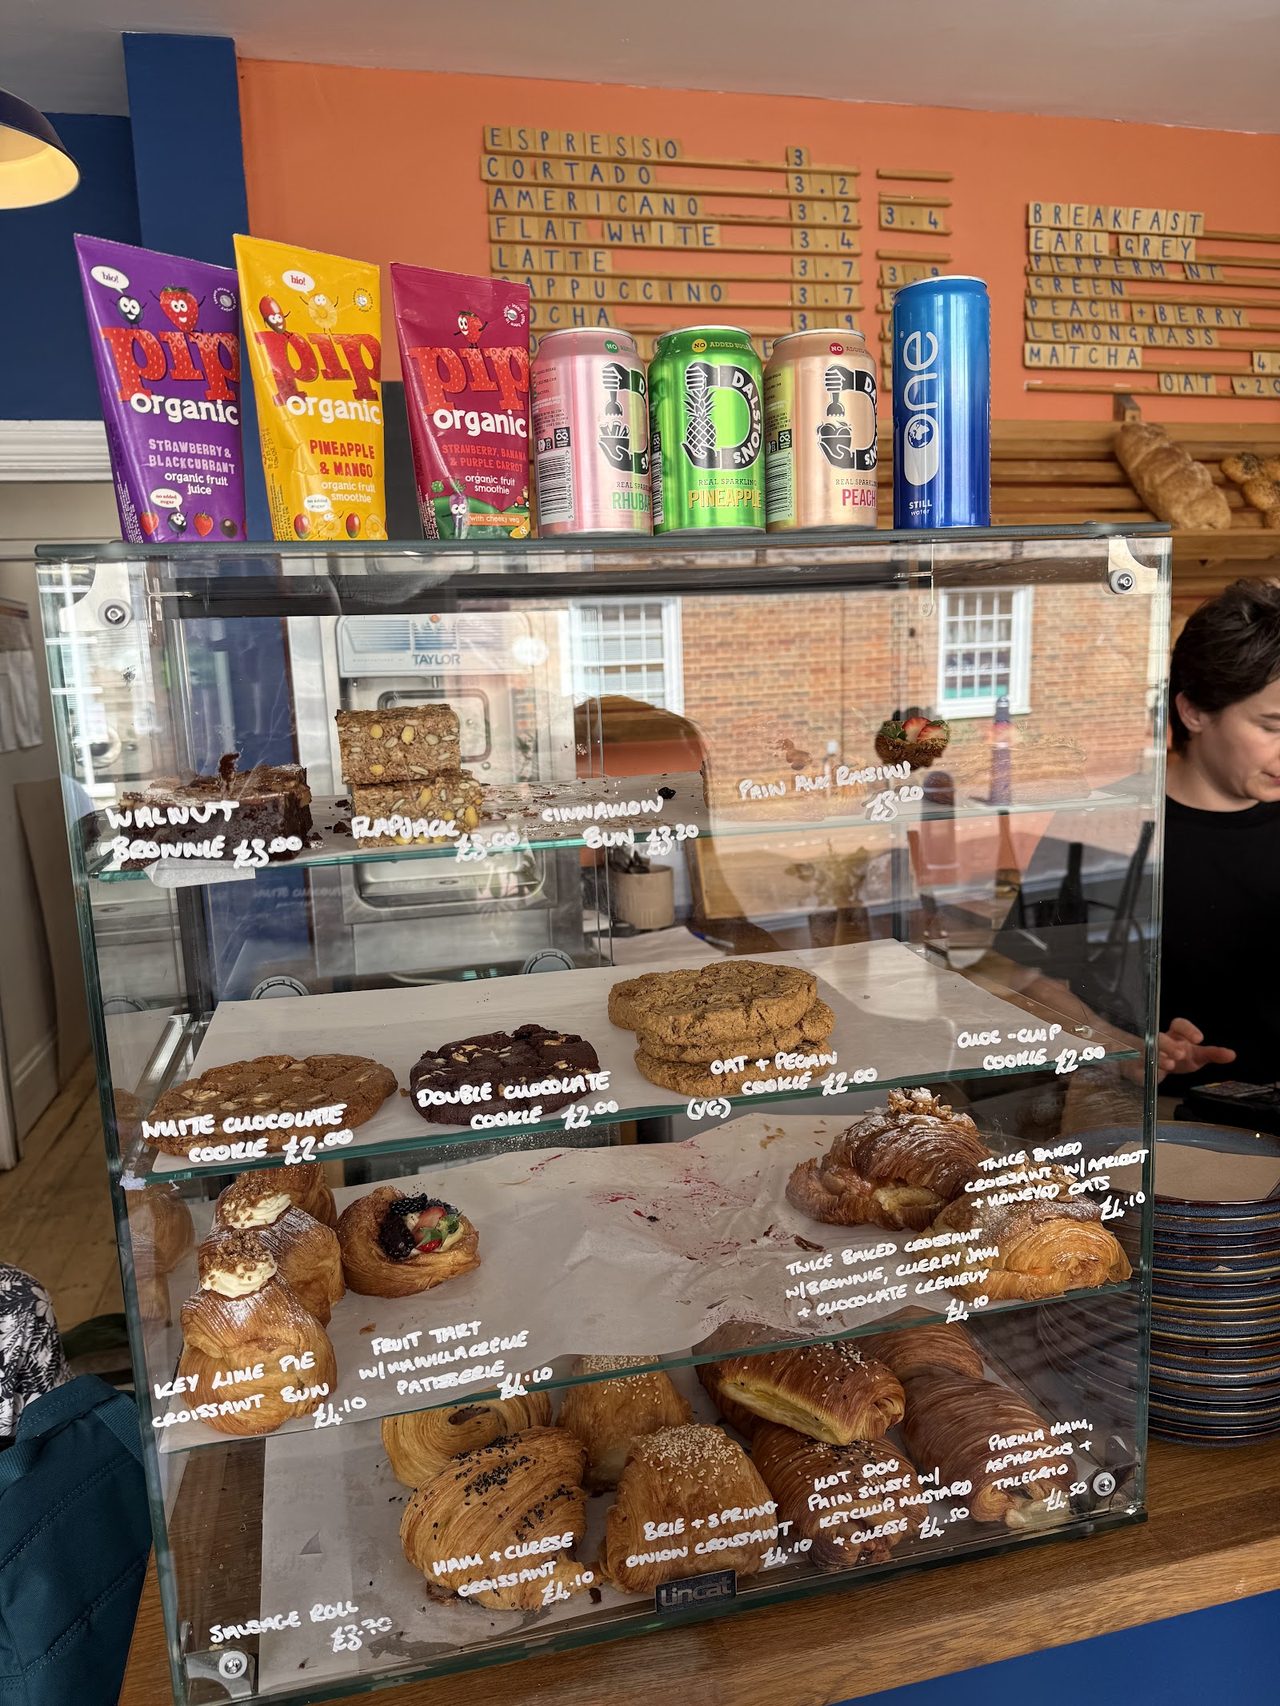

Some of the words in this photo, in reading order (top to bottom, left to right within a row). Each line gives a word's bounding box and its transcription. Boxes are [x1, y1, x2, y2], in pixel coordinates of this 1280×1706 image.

[491, 127, 677, 159] ESPRESSO
[794, 149, 803, 167] 3
[487, 156, 651, 185] CORTADO
[795, 175, 848, 195] 3.2
[493, 187, 698, 216] AMERICANO
[798, 203, 851, 223] 3.2
[885, 207, 938, 229] 3.4
[1033, 203, 1202, 233] BREAKFAST
[496, 217, 582, 241] FLAT
[607, 222, 716, 246] WHITE
[800, 230, 853, 249] 3.4
[1034, 229, 1104, 253] EARL
[1125, 237, 1192, 259] GREY
[498, 247, 606, 273] LATTE
[798, 260, 853, 278] 3.7
[290, 274, 306, 286] bio!
[504, 277, 722, 302] APPUCCINO
[798, 287, 853, 304] 3.7
[1034, 278, 1123, 297] GREEN
[1029, 299, 1120, 320] PEACH
[1158, 304, 1244, 326] BERRY
[1031, 321, 1214, 346] LEMONGRASS
[102, 326, 240, 401] pip
[254, 331, 381, 406] pip
[1028, 346, 1140, 367] MATCHA
[407, 346, 529, 414] pip
[1163, 373, 1212, 393] OAT
[130, 392, 240, 426] organic
[286, 395, 382, 425] organic
[433, 408, 528, 438] organic
[731, 370, 761, 465] DALSTON'S
[148, 438, 222, 457] STRAWBERRY
[223, 447, 232, 458] &
[310, 439, 375, 460] PINEAPPLE
[501, 448, 527, 460] BANANA
[148, 454, 235, 475] BLACKCURRANT
[164, 472, 206, 484] organic
[206, 474, 229, 486] fruit
[320, 461, 330, 475] &
[333, 462, 373, 478] MANGO
[460, 457, 494, 468] PURPLE
[496, 459, 523, 473] CARROT
[187, 484, 212, 495] juice
[321, 481, 357, 492] organic
[357, 481, 376, 493] fruit
[465, 474, 498, 485] organic
[500, 476, 516, 486] fruit
[474, 484, 510, 495] smoothie
[698, 478, 719, 486] REAL
[835, 478, 854, 486] REAL
[331, 492, 372, 503] smoothie
[688, 488, 762, 509] PINEAPPLE
[842, 488, 876, 507] PEACH
[908, 499, 933, 510] STILL
[910, 508, 930, 517] water
[412, 653, 461, 665] TAYLOR
[738, 779, 787, 800] PAIN
[795, 774, 831, 792] AUX
[836, 760, 911, 787] RAISINS
[105, 800, 240, 829] WALNUT
[541, 796, 664, 822] CINNAMON
[351, 814, 460, 840] FLAPJACK
[582, 825, 635, 849] BUN
[111, 835, 226, 862] BROWNIE
[233, 836, 303, 870] £3.00
[709, 1055, 749, 1075] OAT
[755, 1058, 770, 1072] +
[774, 1050, 838, 1071] PECAN
[982, 1048, 1047, 1071] COOKIE
[1054, 1045, 1106, 1075] £2.00
[416, 1081, 493, 1108] DOUBLE
[503, 1070, 612, 1100] CHOCOLATE
[741, 1071, 812, 1096] COOKIE
[820, 1067, 878, 1097] £2.00
[141, 1113, 216, 1139] WHITE
[222, 1103, 348, 1134] CHOCOLATE
[470, 1105, 543, 1130] COOKIE
[560, 1100, 620, 1131] £2.00
[686, 1097, 732, 1121] (VG)
[188, 1137, 269, 1164] COOKIE
[281, 1128, 354, 1166] £2.00
[978, 1150, 1026, 1172] TWICE
[1031, 1141, 1083, 1162] BAKED
[964, 1167, 1052, 1193] CROISSANT
[970, 1197, 984, 1209] +
[987, 1183, 1060, 1208] HONEYED
[1067, 1175, 1111, 1196] OATS
[1098, 1191, 1146, 1222] £4.10
[785, 1253, 834, 1277] TWICE
[840, 1242, 898, 1267] BAKED
[903, 1227, 983, 1253] CROISSANT
[895, 1251, 961, 1277] CHERRY
[966, 1246, 999, 1265] JAM
[796, 1306, 811, 1319] +
[816, 1283, 908, 1318] CHOCOLATE
[944, 1295, 989, 1325] £4.10
[370, 1330, 423, 1356] FRUIT
[428, 1320, 482, 1345] TART
[153, 1373, 200, 1400] KEY
[211, 1363, 265, 1390] LIME
[278, 1350, 316, 1373] PIE
[396, 1359, 505, 1396] PATISSERIE
[151, 1393, 266, 1429] CROISSANT
[279, 1382, 330, 1404] BUN
[312, 1396, 367, 1429] £4.10
[988, 1428, 1045, 1451] PARMA
[984, 1441, 1074, 1474] ASPARAGUS
[1078, 1440, 1093, 1451] +
[814, 1470, 851, 1492] HOT
[862, 1458, 900, 1479] DOG
[807, 1492, 853, 1512] PAIN
[858, 1474, 911, 1500] SUISSE
[899, 1479, 973, 1508] MUSTARD
[643, 1517, 686, 1541] BRIE
[691, 1518, 705, 1530] +
[708, 1500, 779, 1529] SPRING
[832, 1535, 846, 1547] +
[850, 1517, 908, 1545] CHEESE
[432, 1552, 484, 1576] HAM
[489, 1550, 502, 1562] +
[504, 1531, 575, 1560] CHEESE
[625, 1545, 689, 1569] ONION
[694, 1520, 794, 1555] CROISSANT
[759, 1538, 813, 1569] £4.10
[457, 1560, 557, 1597] CROISSANT
[541, 1570, 595, 1606] £4.10
[660, 1575, 734, 1608] Lincat
[208, 1610, 302, 1644] SAUSAGE
[309, 1600, 359, 1623] ROLL
